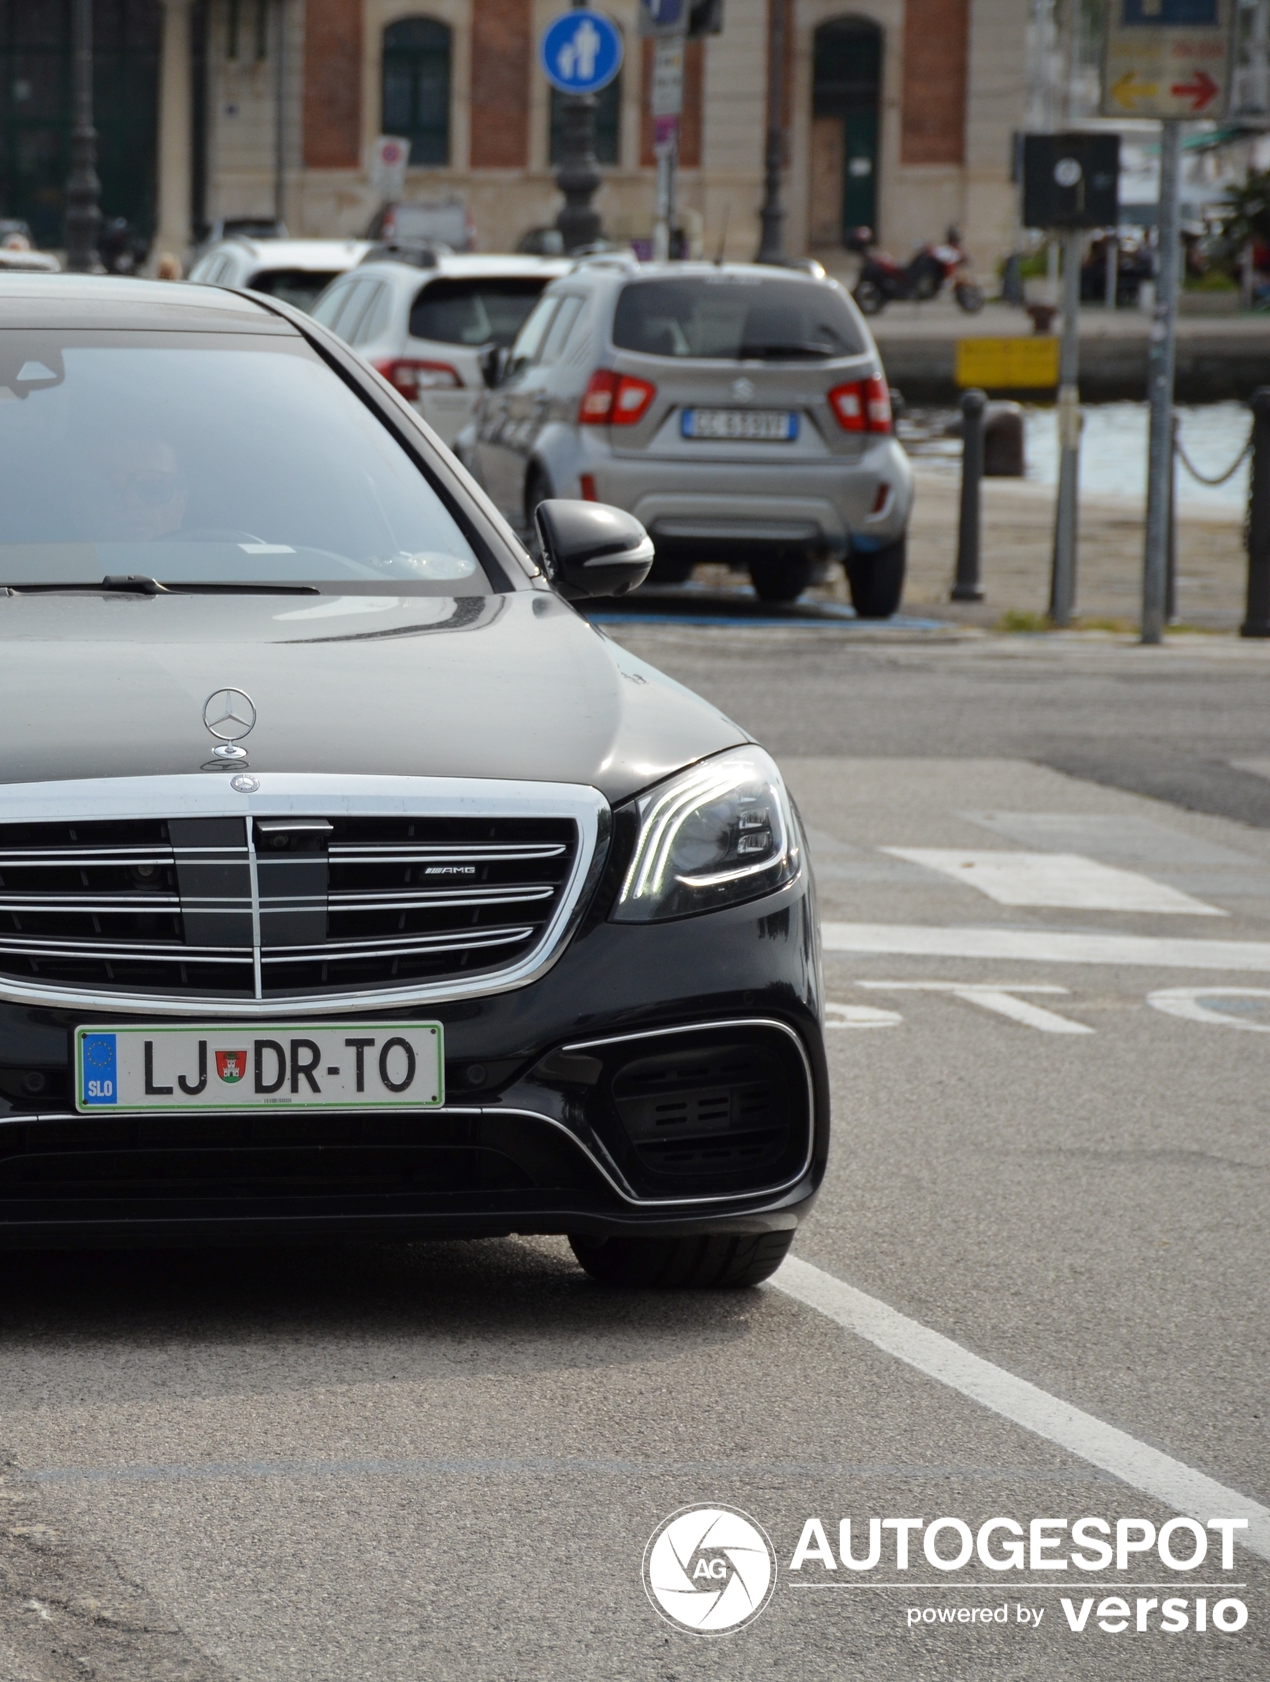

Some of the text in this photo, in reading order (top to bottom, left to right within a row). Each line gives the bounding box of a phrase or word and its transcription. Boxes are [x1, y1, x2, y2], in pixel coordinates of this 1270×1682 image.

[144, 1036, 417, 1095] LJ DR-TO
[88, 1080, 113, 1098] SLO
